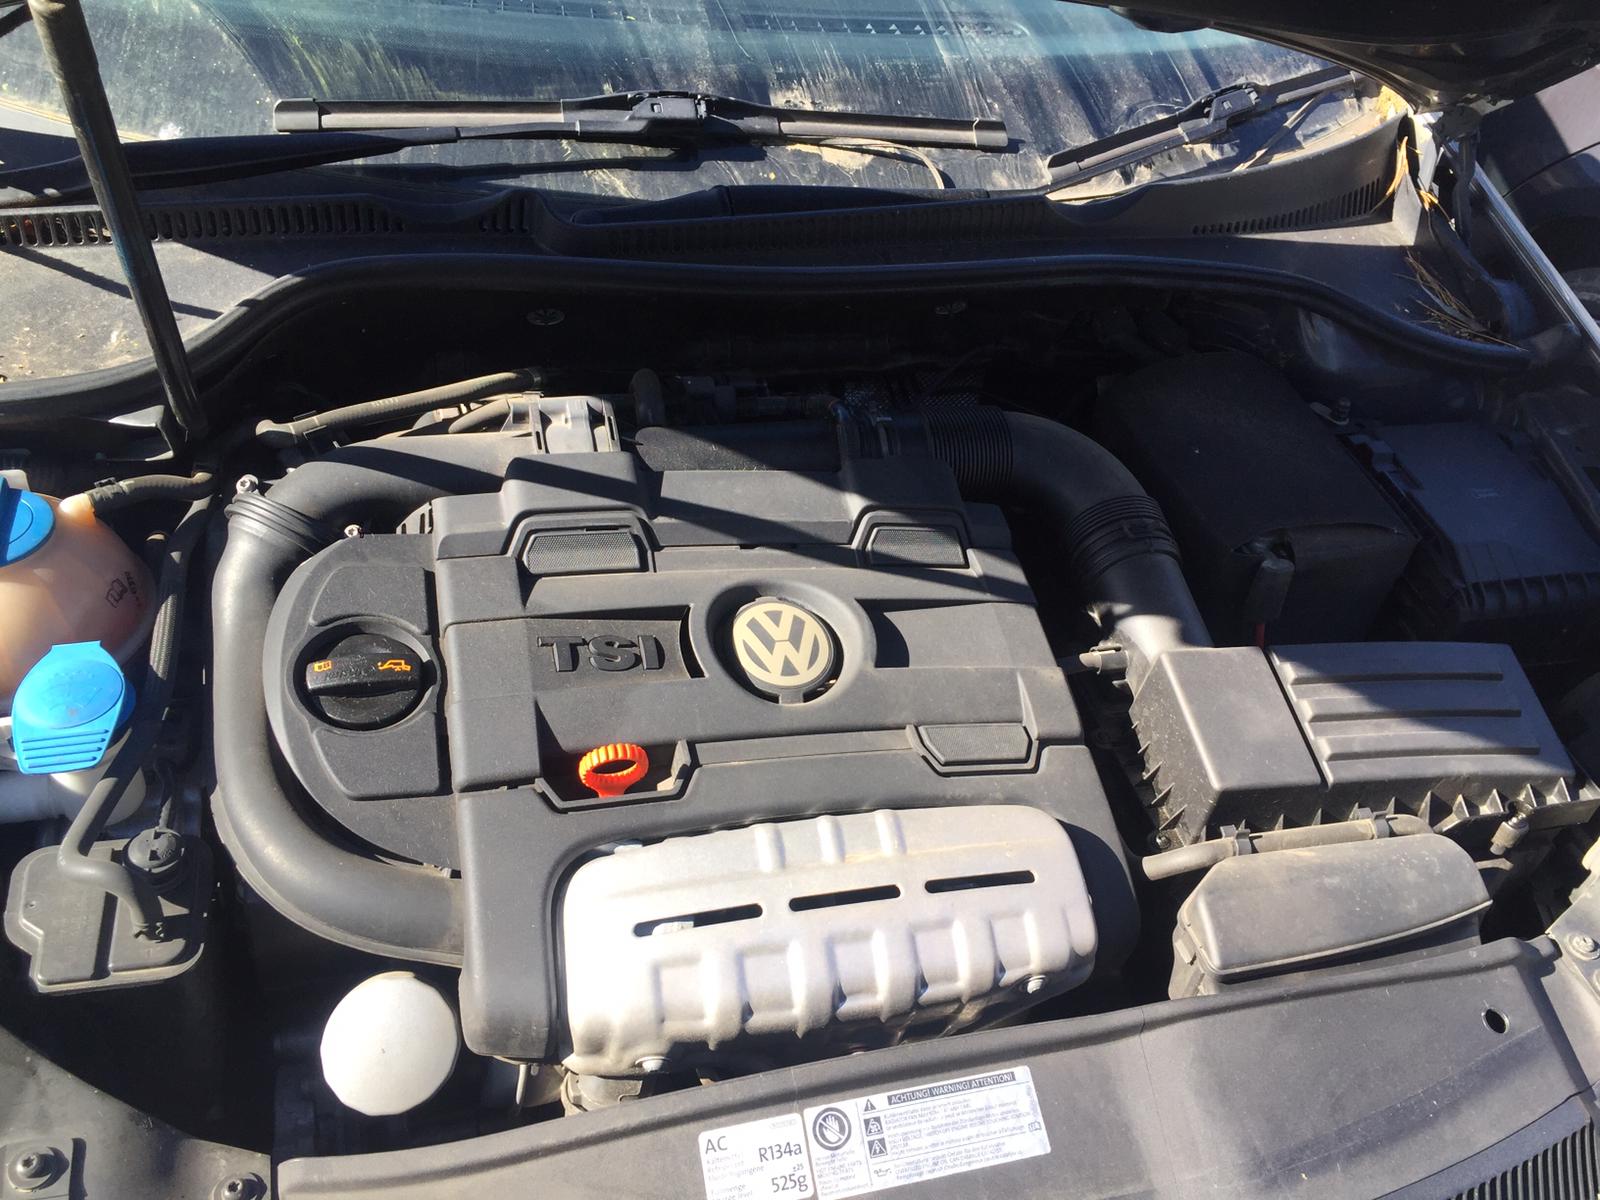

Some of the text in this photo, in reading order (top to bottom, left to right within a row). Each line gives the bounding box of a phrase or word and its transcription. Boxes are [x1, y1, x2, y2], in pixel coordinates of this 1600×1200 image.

[537, 634, 665, 672] TSI
[890, 1072, 1013, 1104] ACHTUNG! WARNING! ATTENTION!
[705, 1135, 728, 1155] AC
[758, 1141, 803, 1163] R134a
[771, 1173, 809, 1193] 525g
